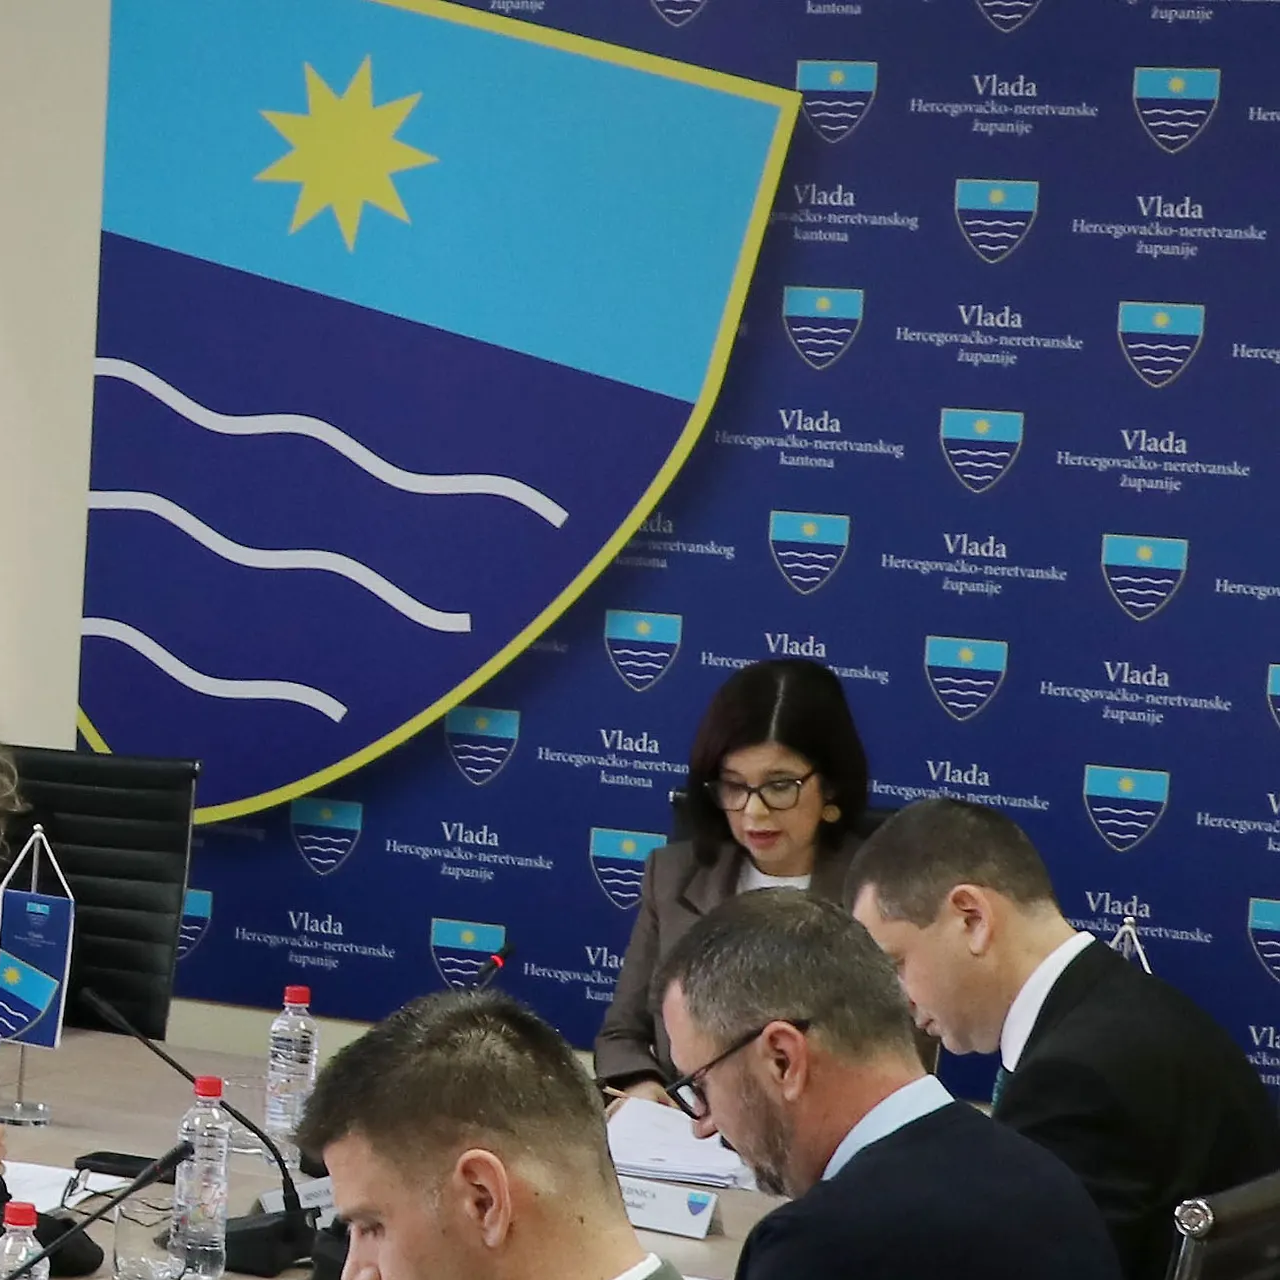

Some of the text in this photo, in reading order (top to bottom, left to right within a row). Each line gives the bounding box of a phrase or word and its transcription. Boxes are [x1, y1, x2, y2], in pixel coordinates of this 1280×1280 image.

[806, 0, 862, 15] kantona
[1151, 6, 1214, 24] županije
[972, 74, 1037, 97] Vlada
[909, 98, 1098, 118] Hercegovačko-neretvanske
[972, 118, 1033, 137] županije
[794, 184, 856, 207] Vlada
[1136, 196, 1204, 219] Vlada
[793, 227, 849, 243] kantona
[1072, 219, 1267, 241] Hercegovačko-neretvanske
[1135, 241, 1198, 260] županije
[958, 305, 1023, 329] Vlada
[896, 327, 1084, 350] Hercegovačko-neretvanske
[957, 348, 1017, 368] županije
[779, 409, 841, 433] Vlada
[715, 430, 905, 459] Hercegovačko-neretvanskog
[1120, 429, 1187, 455] Vlada
[779, 452, 835, 468] kantona
[1056, 451, 1250, 478] Hercegovačko-neretvanske
[1119, 474, 1182, 494] županije
[943, 532, 1007, 559] Vlada
[881, 553, 1068, 582] Hercegovačko-neretvanske
[943, 577, 1002, 597] županije
[764, 632, 826, 658] Vlada
[1104, 660, 1170, 688] Vlada
[1040, 680, 1232, 712] Hercegovačko-neretvanske
[1102, 707, 1164, 727] županije
[599, 728, 659, 754] Vlada
[537, 746, 689, 775] Hercegovačko-neretvan
[599, 770, 653, 788] kantona
[926, 760, 991, 787] Vlada
[441, 821, 499, 847] Vlada
[385, 839, 554, 870] Hercegovačko-neretvanske
[440, 862, 495, 882] županije
[1085, 890, 1151, 919] Vlada
[288, 910, 344, 935] Vlada
[235, 926, 396, 959] Hercegovačko-neretvanske
[288, 950, 339, 970] županije
